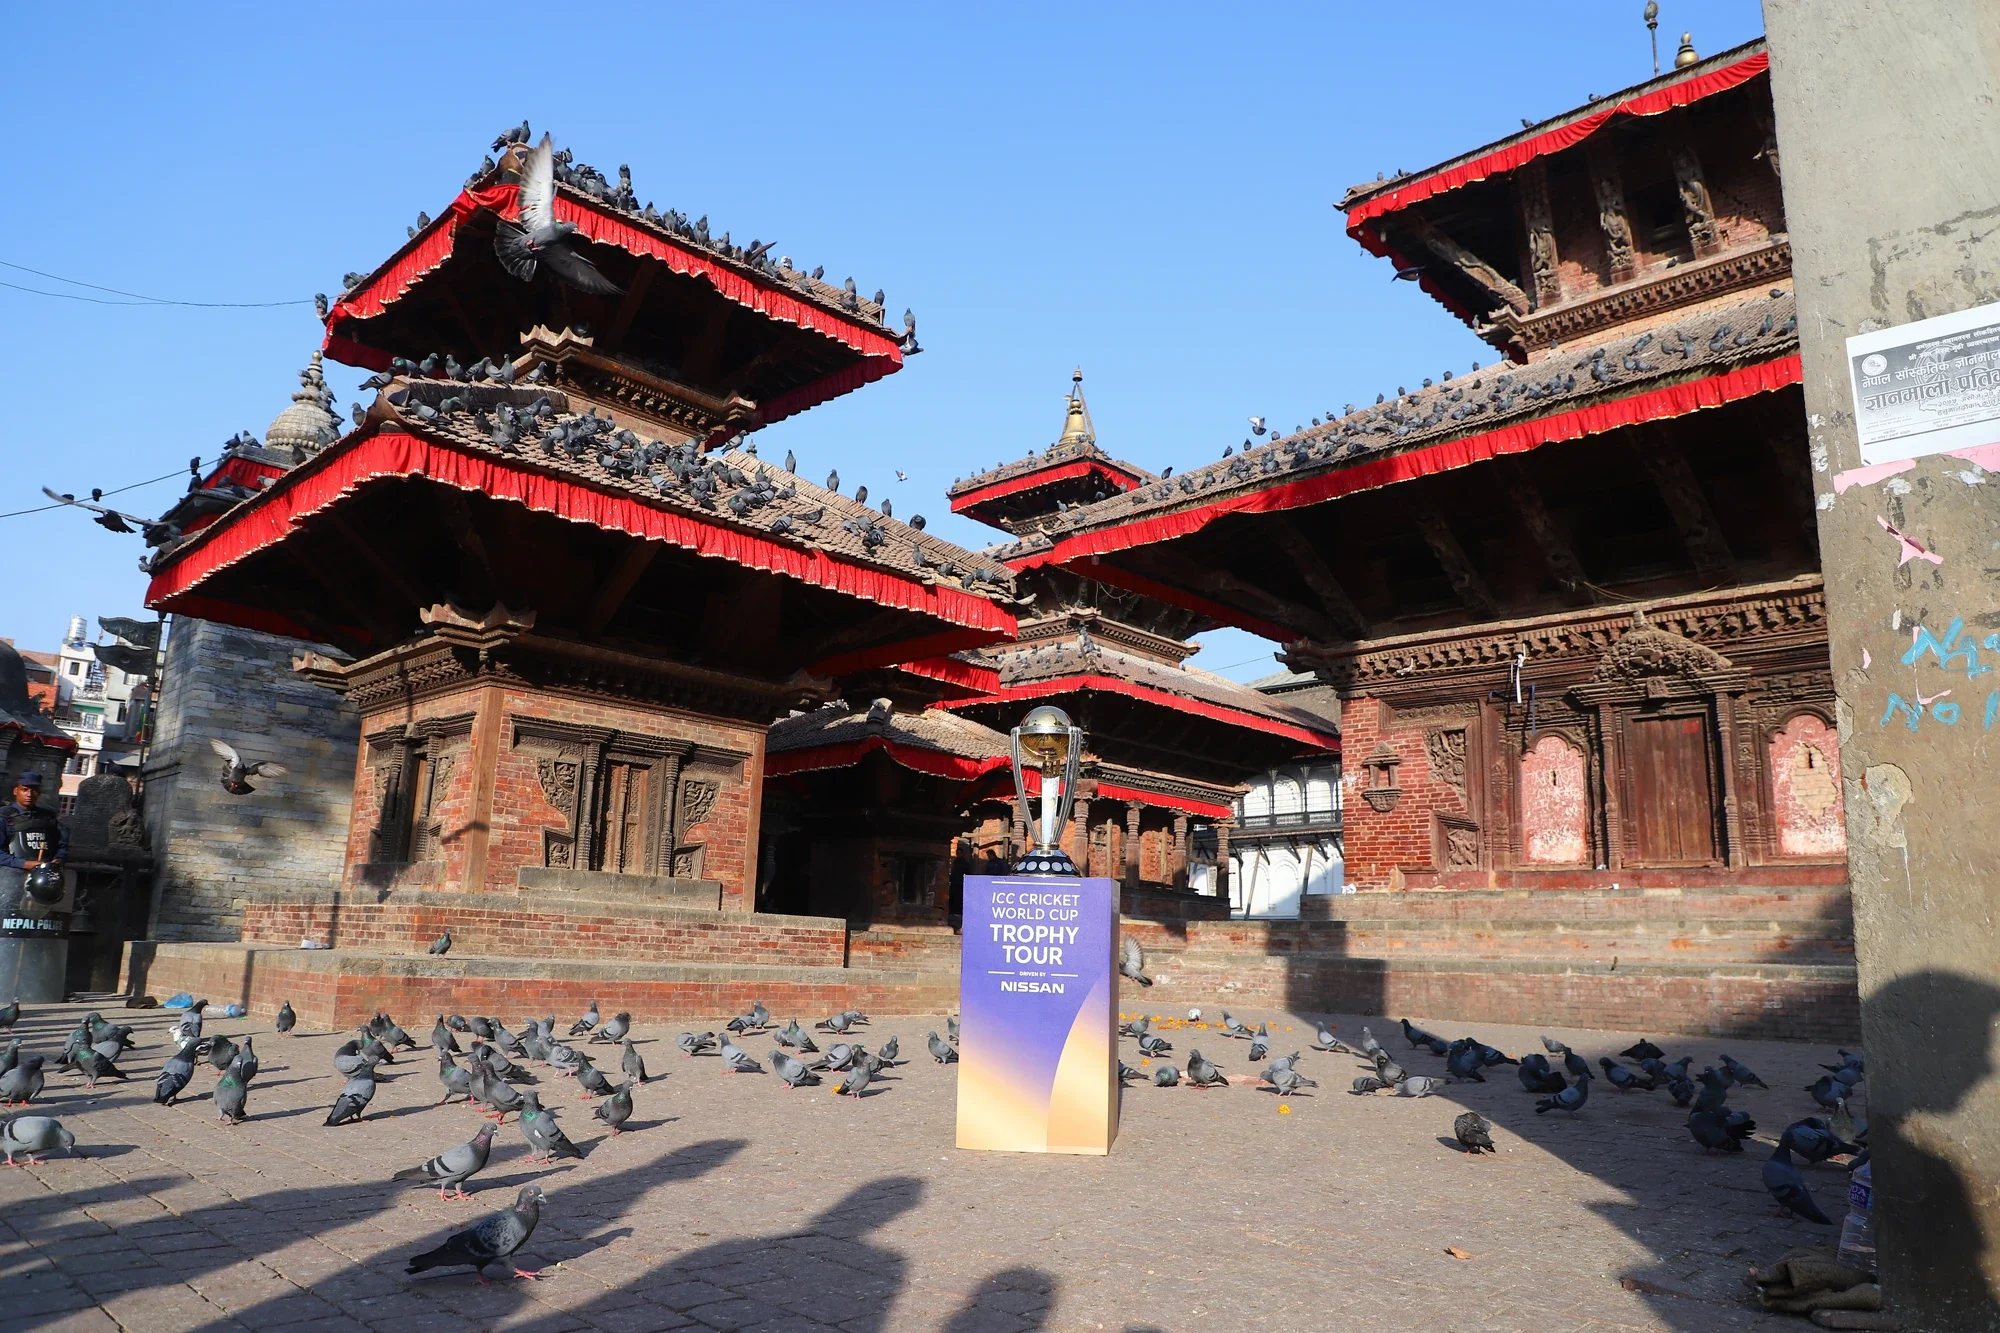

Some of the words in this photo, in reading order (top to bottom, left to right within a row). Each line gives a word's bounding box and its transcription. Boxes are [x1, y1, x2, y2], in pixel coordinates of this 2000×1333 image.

[1861, 373, 1891, 388] नेपाल
[1863, 379, 1951, 412] ज्ञानमाला
[991, 892, 1016, 904] ICC
[1019, 893, 1080, 907] CRICKET
[991, 907, 1045, 920] WORLD
[1049, 909, 1079, 921] CUP
[2, 918, 36, 930] NEPAL
[989, 923, 1080, 945] TROPHY
[1002, 945, 1063, 965] TOUR
[1000, 981, 1065, 994] NISSAN
